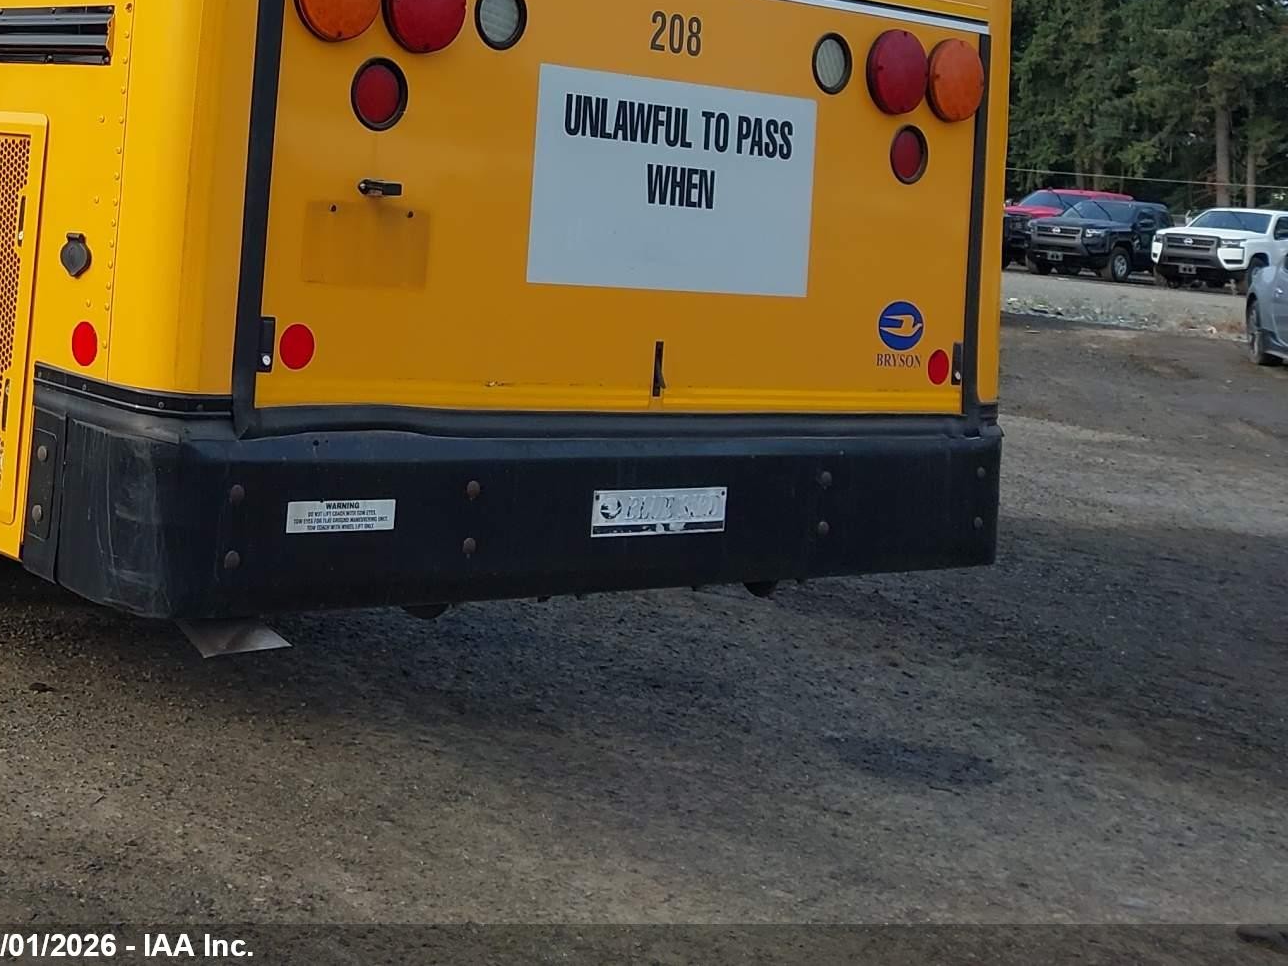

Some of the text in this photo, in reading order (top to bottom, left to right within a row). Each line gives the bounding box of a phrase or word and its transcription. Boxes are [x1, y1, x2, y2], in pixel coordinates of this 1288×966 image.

[650, 11, 702, 57] 208
[564, 93, 793, 160] UNLAWFUL TO PASS
[647, 163, 715, 209] WHEN
[876, 353, 921, 368] BRYSON
[326, 502, 360, 510] WARNING
